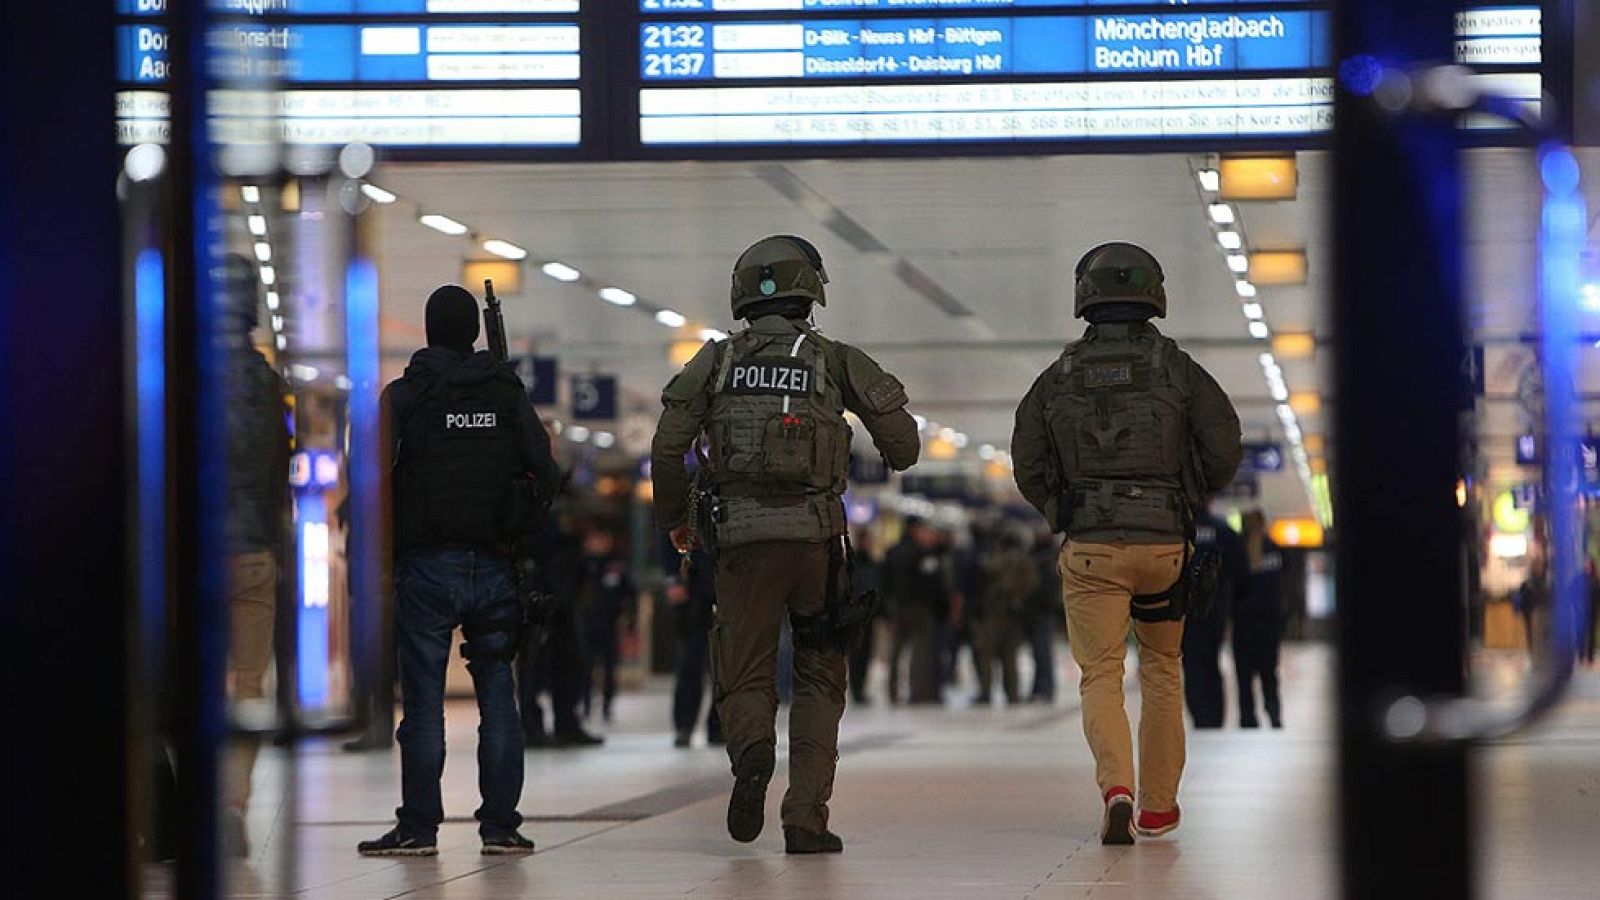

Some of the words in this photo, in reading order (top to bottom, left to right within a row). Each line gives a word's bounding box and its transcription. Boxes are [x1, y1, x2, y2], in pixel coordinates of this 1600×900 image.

[643, 26, 704, 47] 21:32
[908, 28, 935, 43] Hbf
[1095, 15, 1284, 43] Mönchengladbach
[643, 53, 704, 76] 21:37
[908, 56, 972, 75] Duisburg
[975, 53, 1002, 70] Hbf
[1095, 46, 1179, 68] Bochum
[1186, 44, 1223, 66] Hbf
[732, 365, 809, 392] POLIZEI
[446, 412, 497, 429] POLIZEI
